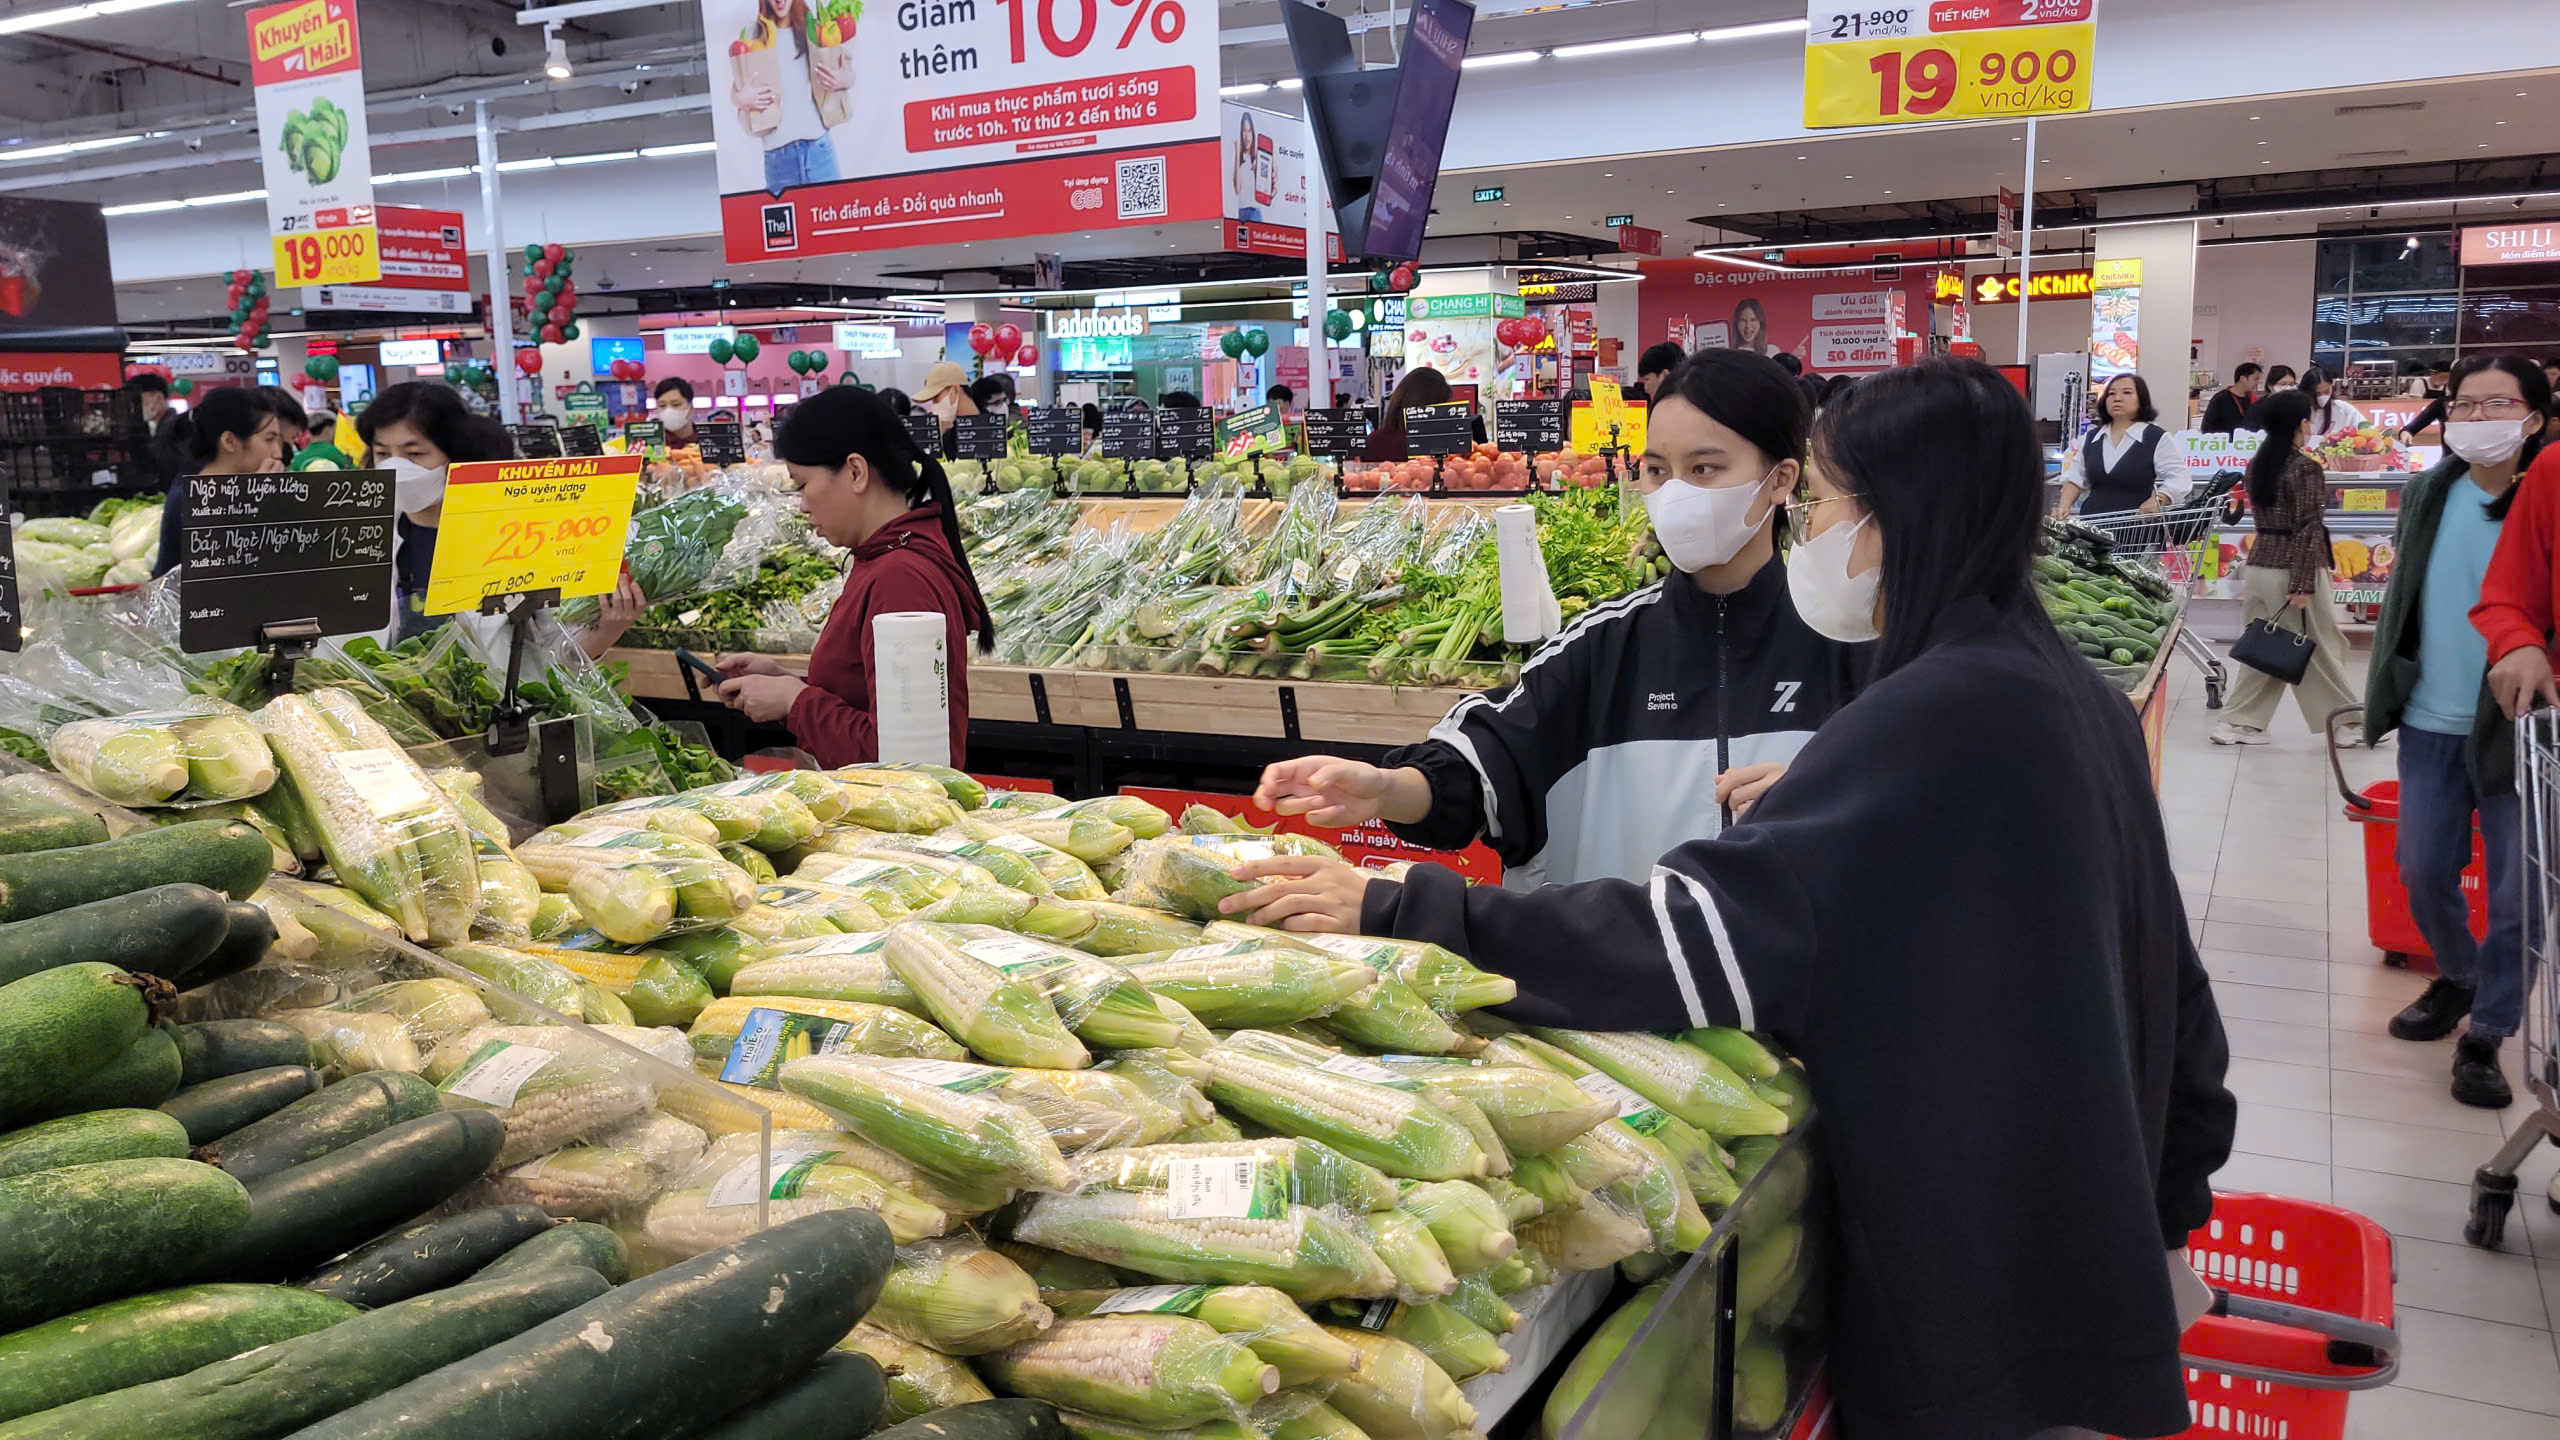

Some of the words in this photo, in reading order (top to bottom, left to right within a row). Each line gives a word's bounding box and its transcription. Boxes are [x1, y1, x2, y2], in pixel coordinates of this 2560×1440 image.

[1935, 7, 1961, 22] TIẾT
[1962, 7, 1990, 21] KIỆM
[2040, 8, 2078, 18] vnd/kg
[1869, 26, 1907, 36] vnd/kg
[900, 44, 978, 79] thêm
[931, 104, 955, 121] Khi
[959, 103, 991, 117] mua
[995, 95, 1028, 116] thực
[1032, 86, 1077, 114] phẩm
[1081, 82, 1114, 101] tươi
[1118, 77, 1159, 97] sống
[1980, 86, 2074, 109] vnd/kg
[933, 124, 974, 143] trước
[1012, 115, 1032, 135] Từ
[1035, 113, 1061, 129] thứ
[1065, 111, 1075, 126] 2
[1079, 105, 1110, 125] đến
[1114, 102, 1142, 119] thứ
[1146, 101, 1157, 117] 6
[1475, 190, 1495, 201] EXIT
[811, 205, 838, 223] Tích
[838, 200, 873, 222] điểm
[902, 192, 928, 213] Đổi
[930, 194, 956, 215] quà
[959, 188, 1003, 208] nhanh
[1607, 217, 1625, 227] EXIT
[1694, 271, 1723, 287] Đặc
[1430, 298, 1473, 311] CHANG
[1475, 297, 1488, 309] HI
[1047, 306, 1143, 339] Ladofoods
[1832, 337, 1860, 345] 10.000
[1827, 350, 1846, 362] 50
[1850, 346, 1887, 361] điểm
[1519, 362, 1525, 372] 2
[2186, 435, 2229, 452] Trái
[497, 460, 566, 481] KHUYẾN
[504, 485, 528, 497] Ngô
[531, 484, 556, 495] uyên
[560, 482, 586, 494] ương
[1648, 692, 1675, 702] Project
[1647, 702, 1671, 711] Seven
[1341, 829, 1364, 843] mỗi
[1367, 834, 1398, 848] ngày
